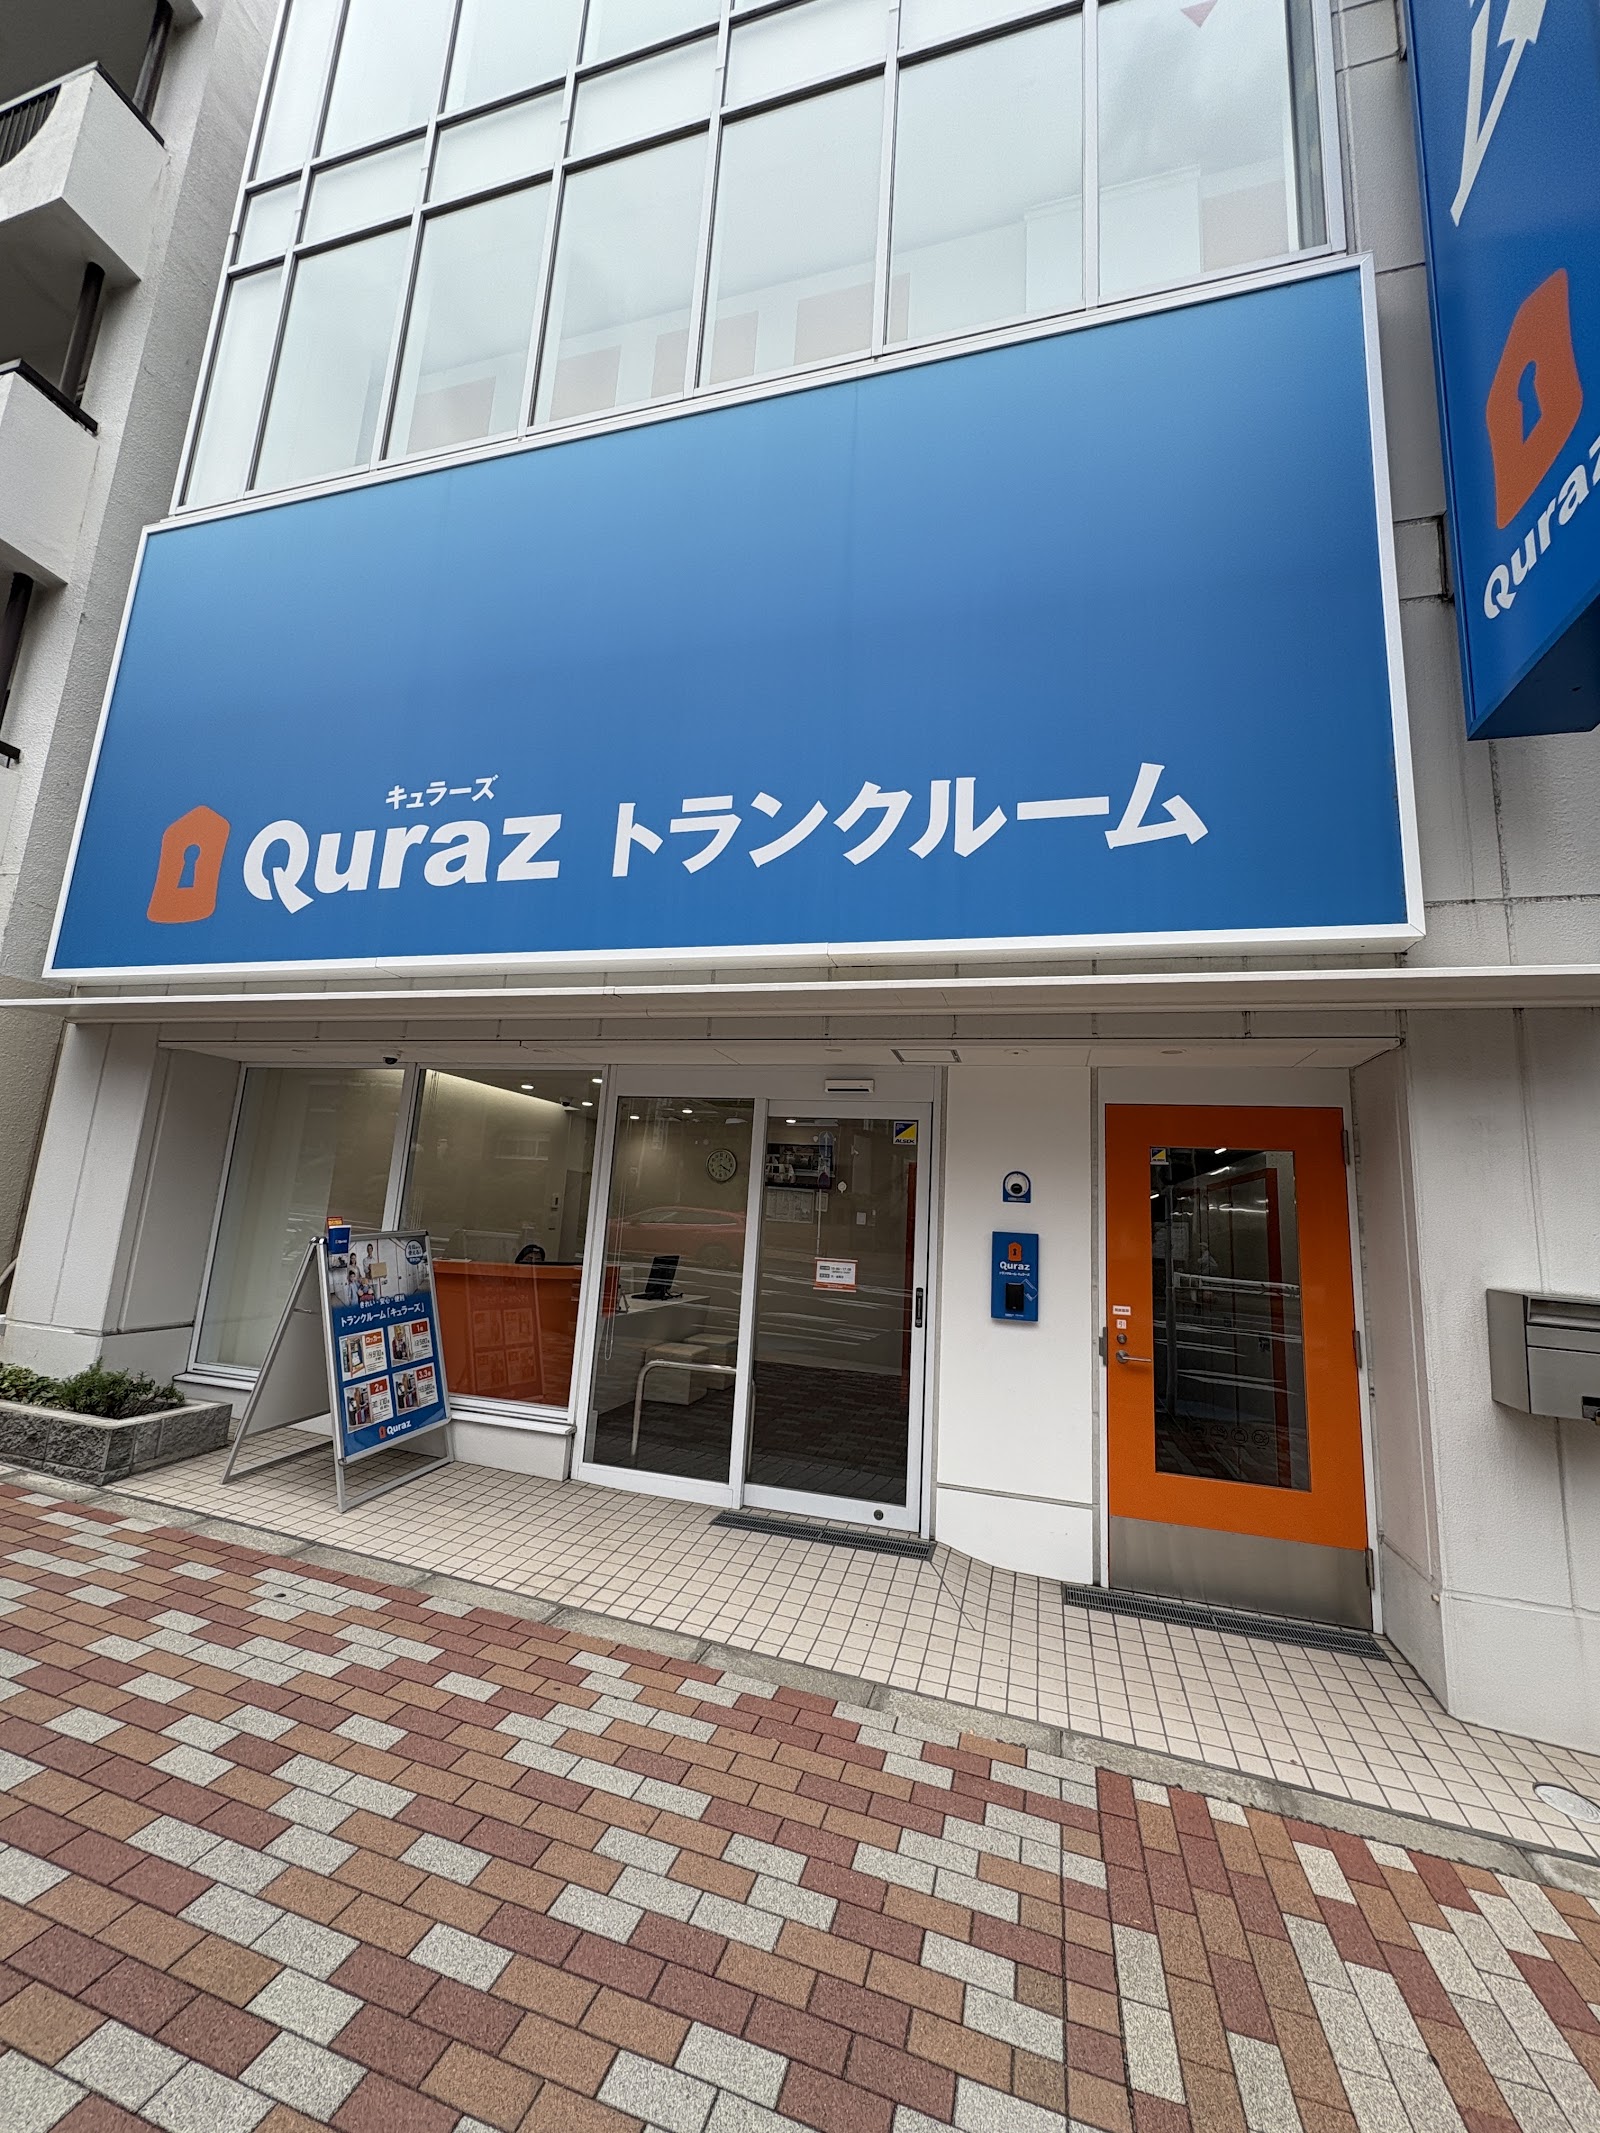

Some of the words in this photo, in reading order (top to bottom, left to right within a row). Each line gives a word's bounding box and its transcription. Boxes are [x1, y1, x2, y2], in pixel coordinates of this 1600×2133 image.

[385, 773, 499, 810] キュラーズ
[242, 812, 562, 914] Quraz
[612, 762, 1209, 877] トランクルーム
[999, 1261, 1031, 1271] Quraz
[386, 1420, 412, 1435] Quraz
